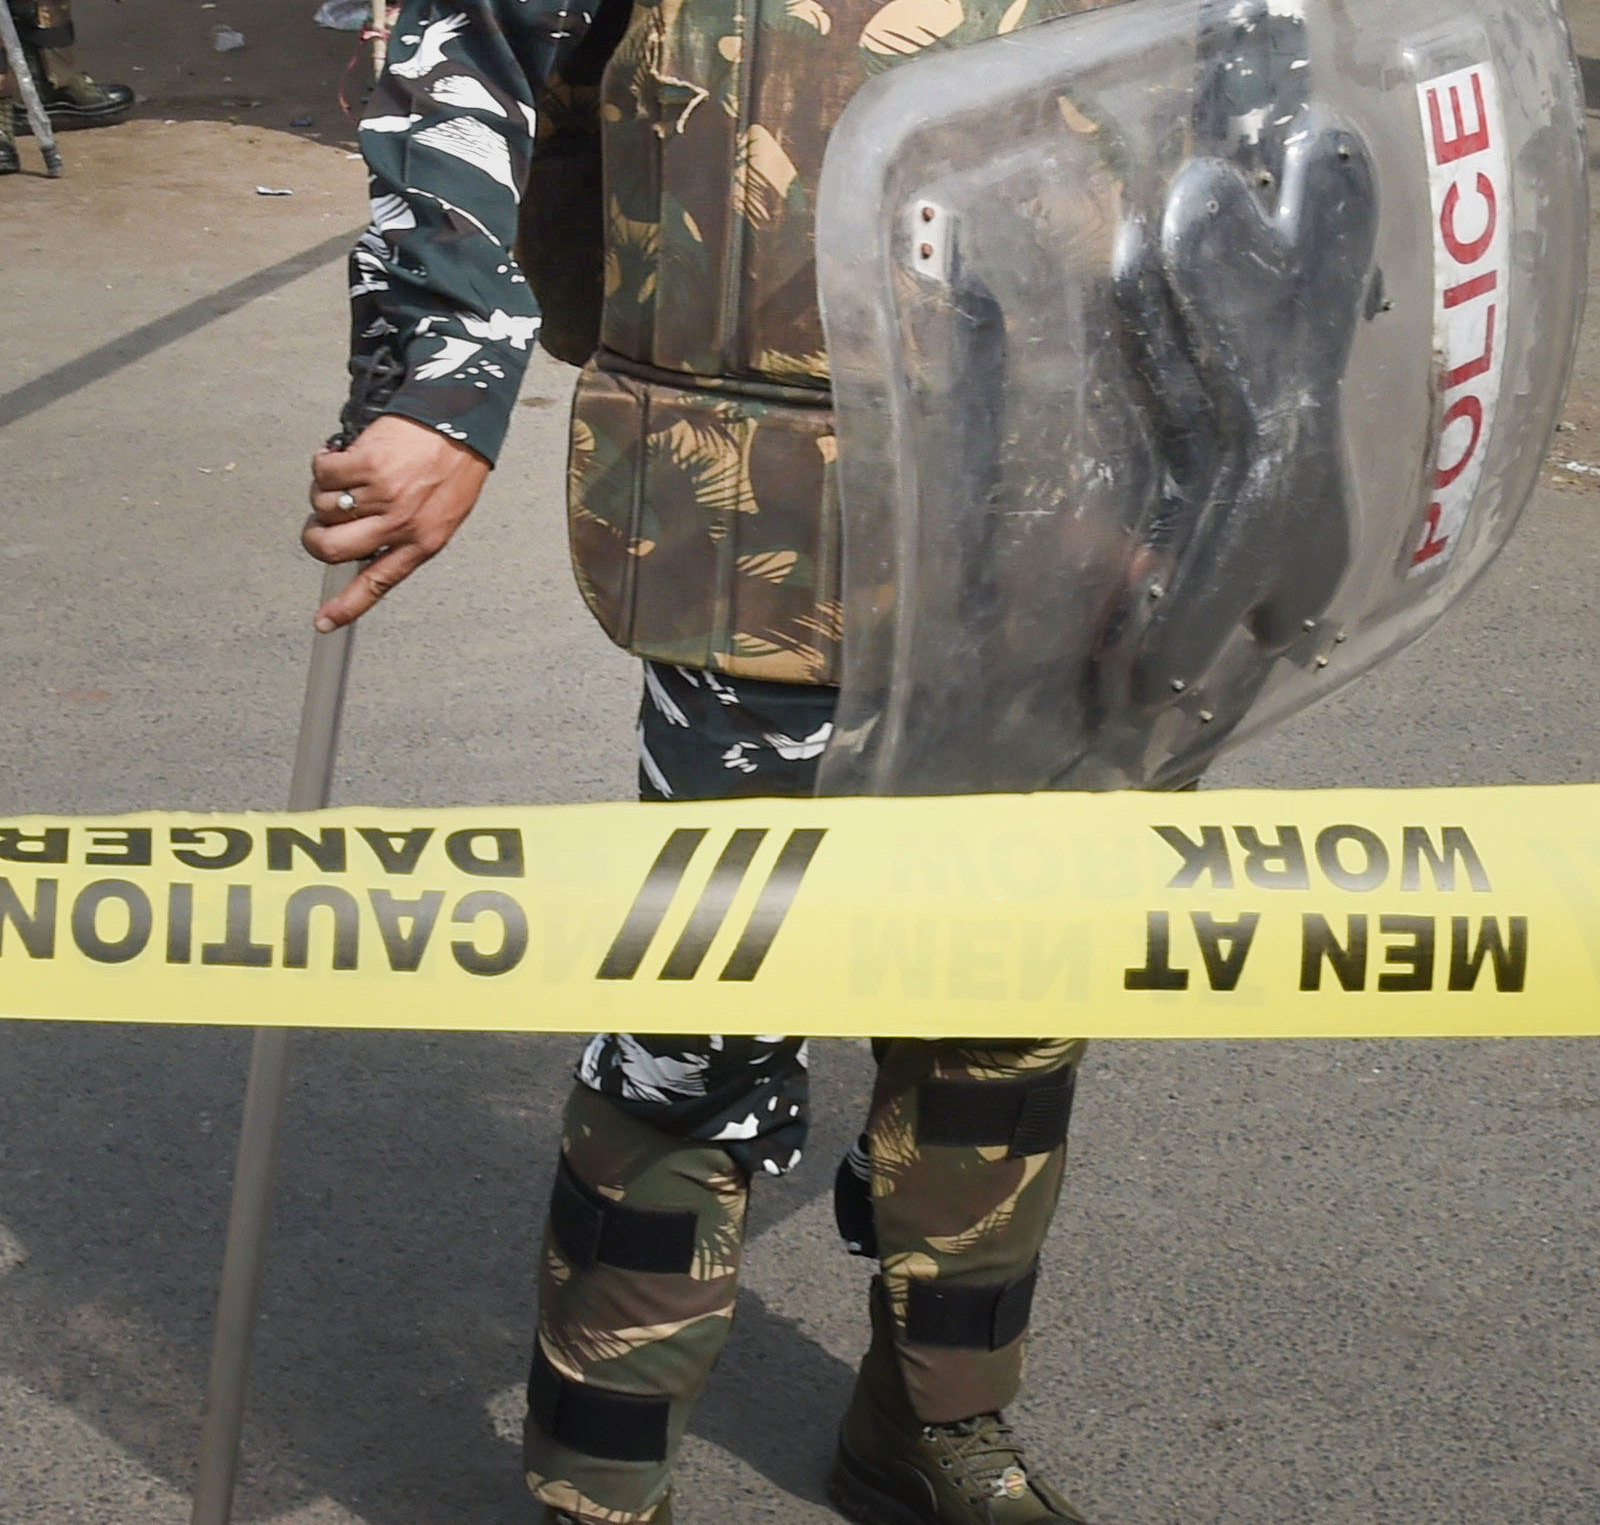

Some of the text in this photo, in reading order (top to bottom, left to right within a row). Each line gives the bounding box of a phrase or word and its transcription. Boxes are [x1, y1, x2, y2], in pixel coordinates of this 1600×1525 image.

[1410, 70, 1499, 568] POLICE
[1150, 824, 1493, 892] WORK
[1123, 909, 1259, 994] AT
[1299, 913, 1529, 994] MEN
